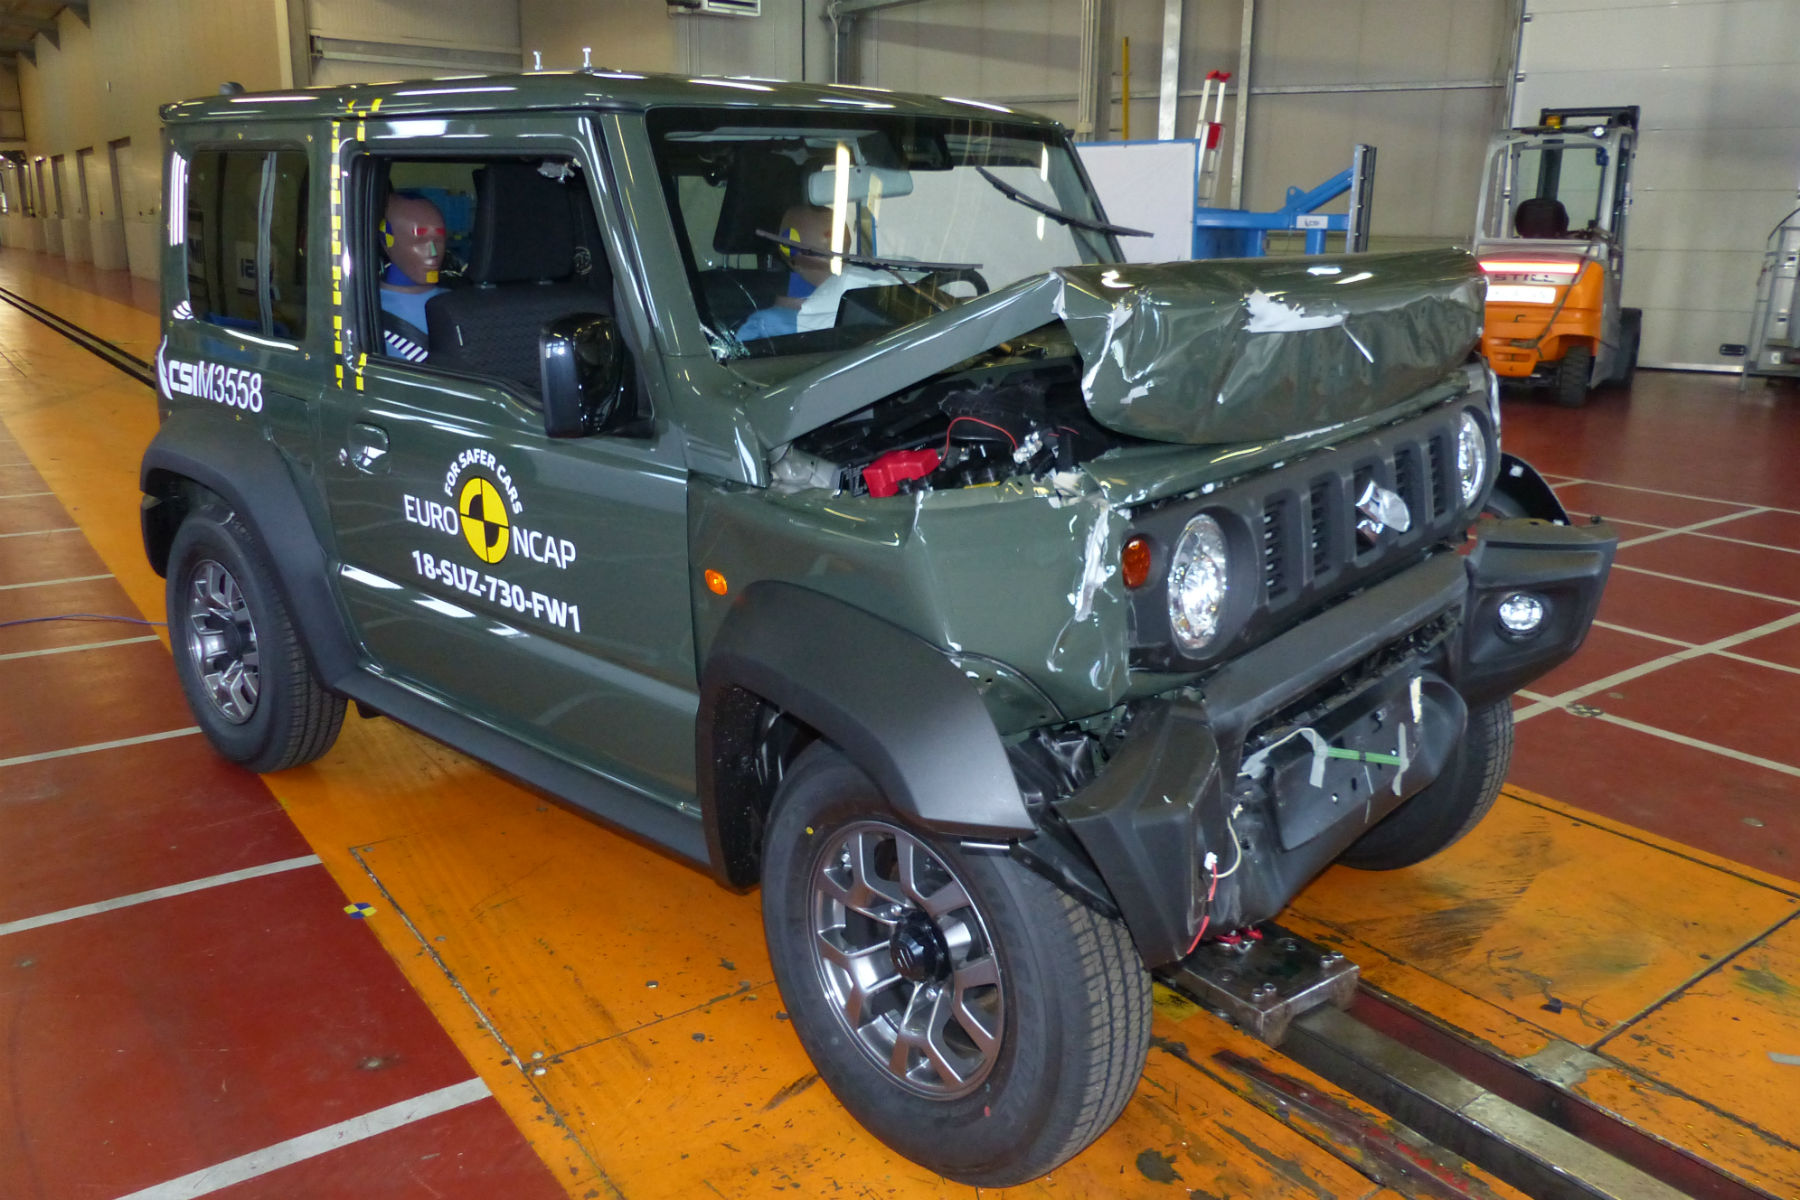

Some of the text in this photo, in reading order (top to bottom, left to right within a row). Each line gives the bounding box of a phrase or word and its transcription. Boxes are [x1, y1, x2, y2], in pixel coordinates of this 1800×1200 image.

[443, 447, 524, 515] FOR SAFER CARS
[403, 493, 577, 570] EURO NCAP
[411, 549, 582, 634] 18-SUZ-730-FW1
